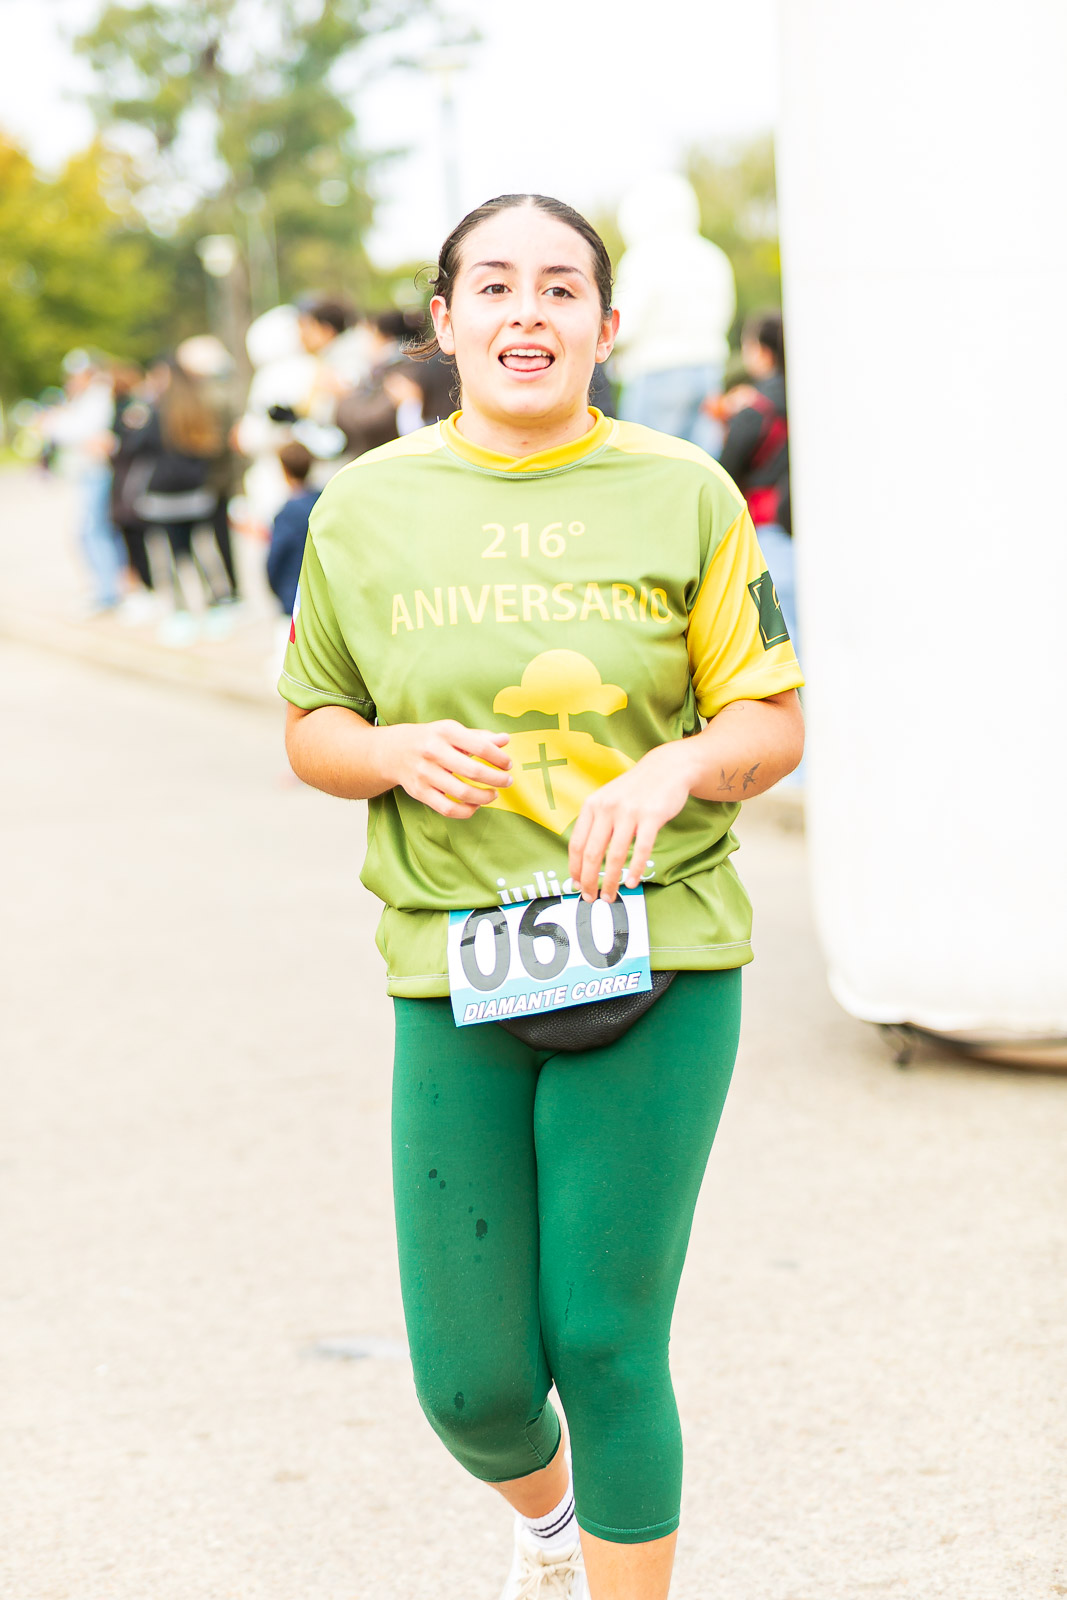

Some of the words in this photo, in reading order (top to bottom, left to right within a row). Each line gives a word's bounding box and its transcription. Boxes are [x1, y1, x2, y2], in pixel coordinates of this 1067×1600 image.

[391, 582, 673, 635] ANIVERSARIO
[460, 889, 630, 992] 060
[463, 985, 569, 1022] DIAMANTE
[571, 971, 643, 1000] CORRE
